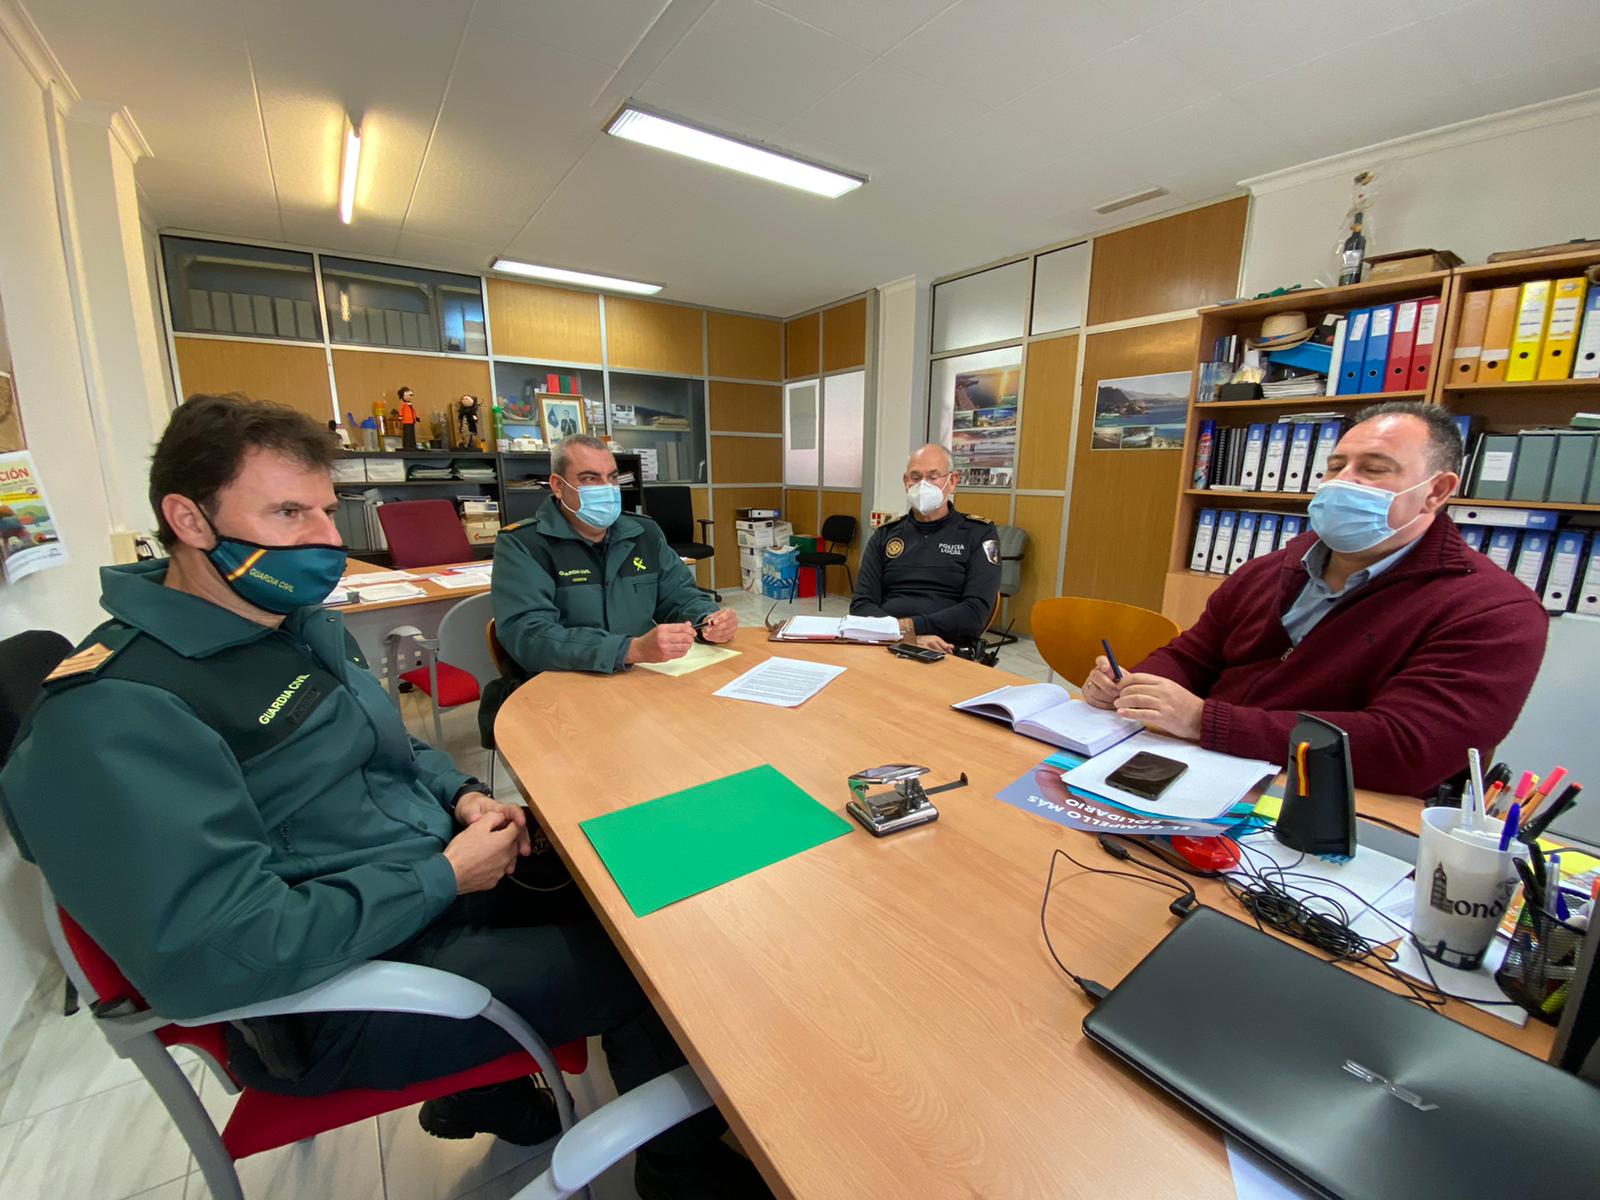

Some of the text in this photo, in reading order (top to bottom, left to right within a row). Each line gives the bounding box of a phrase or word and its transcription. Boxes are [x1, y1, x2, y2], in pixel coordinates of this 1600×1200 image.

[249, 567, 294, 593] GUARDIA CIVIL
[258, 690, 295, 725] GUARDIA
[1026, 795, 1065, 813] MÁS
[1066, 810, 1164, 831] CAMPELLO
